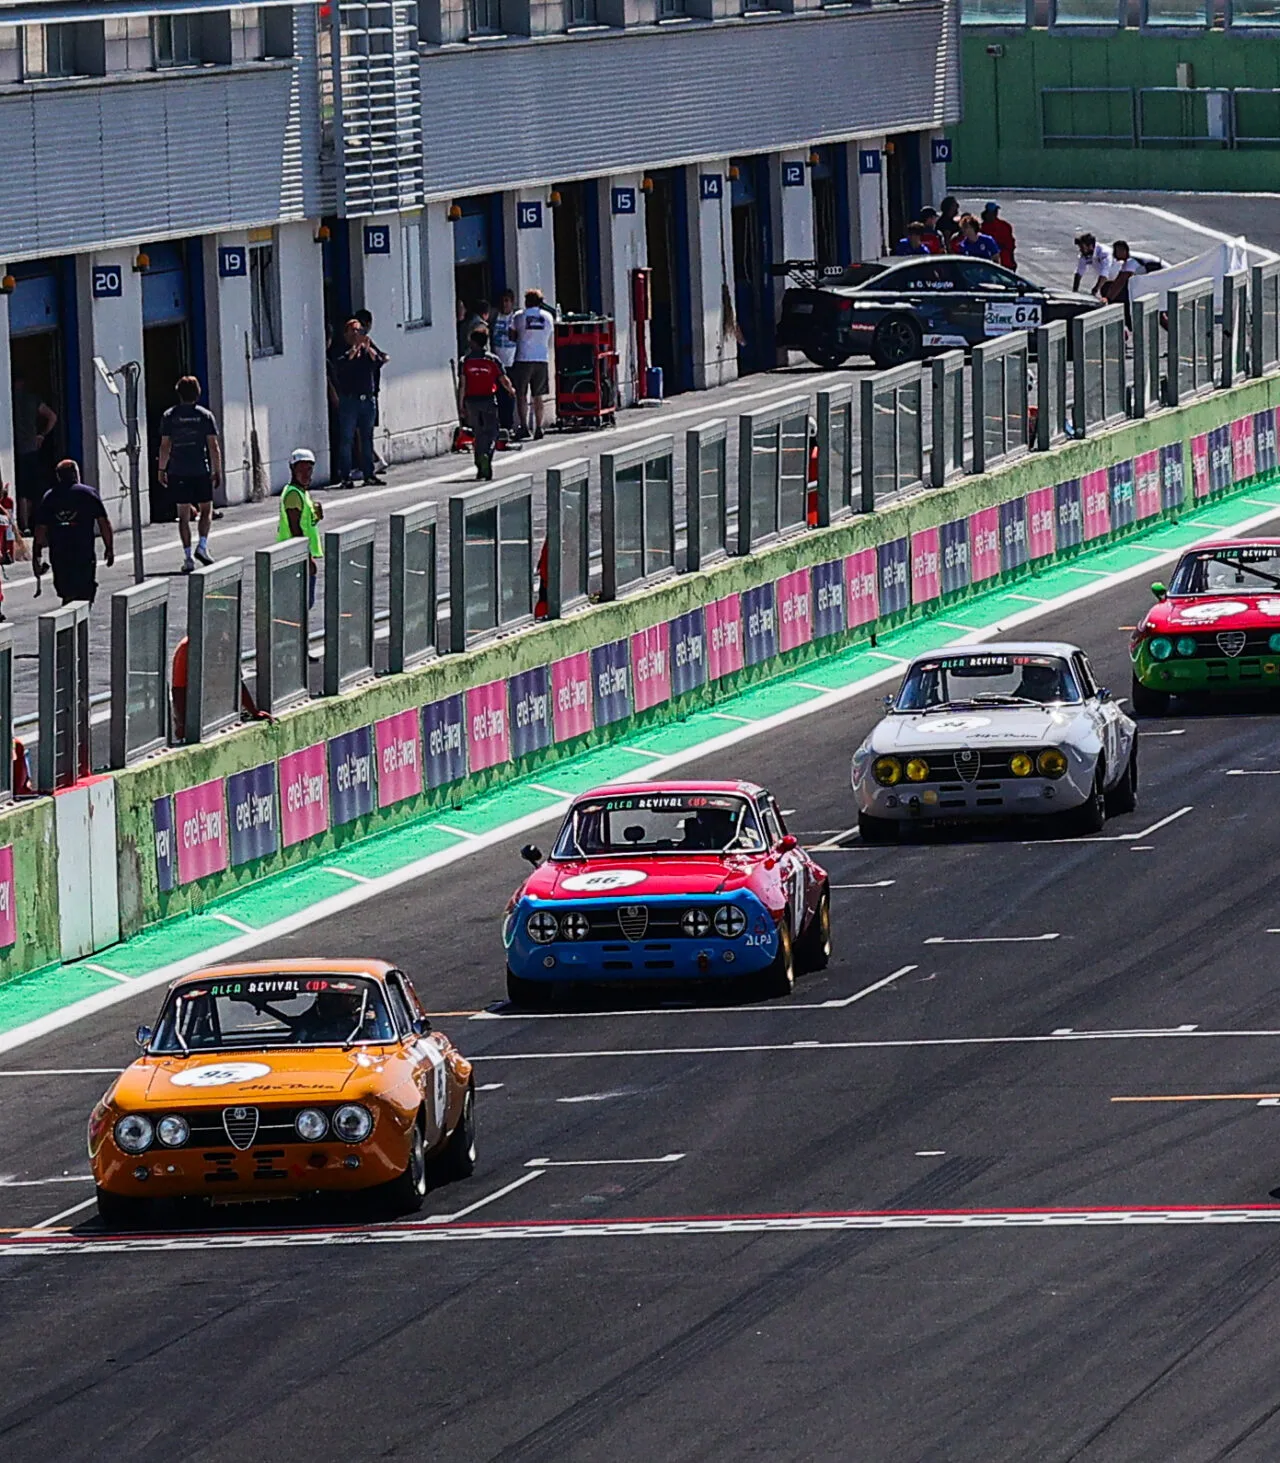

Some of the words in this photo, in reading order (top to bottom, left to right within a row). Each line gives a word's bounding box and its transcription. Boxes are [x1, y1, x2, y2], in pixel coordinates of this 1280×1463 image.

[936, 145, 948, 158] 10
[866, 156, 873, 168] 11
[786, 168, 800, 180] 12
[703, 180, 717, 194] 14
[617, 194, 630, 208] 15
[522, 208, 538, 223] 16
[368, 232, 384, 248] 18
[224, 253, 240, 270] 19
[95, 273, 119, 292] 20
[1015, 307, 1040, 323] 64
[970, 657, 1008, 666] REVIVAL
[638, 798, 682, 808] REVIVAL
[746, 934, 772, 946] ALPA
[210, 984, 242, 996] ALFA
[248, 981, 300, 992] REVIVAL
[305, 981, 328, 991] CUP
[200, 1070, 235, 1080] 95
